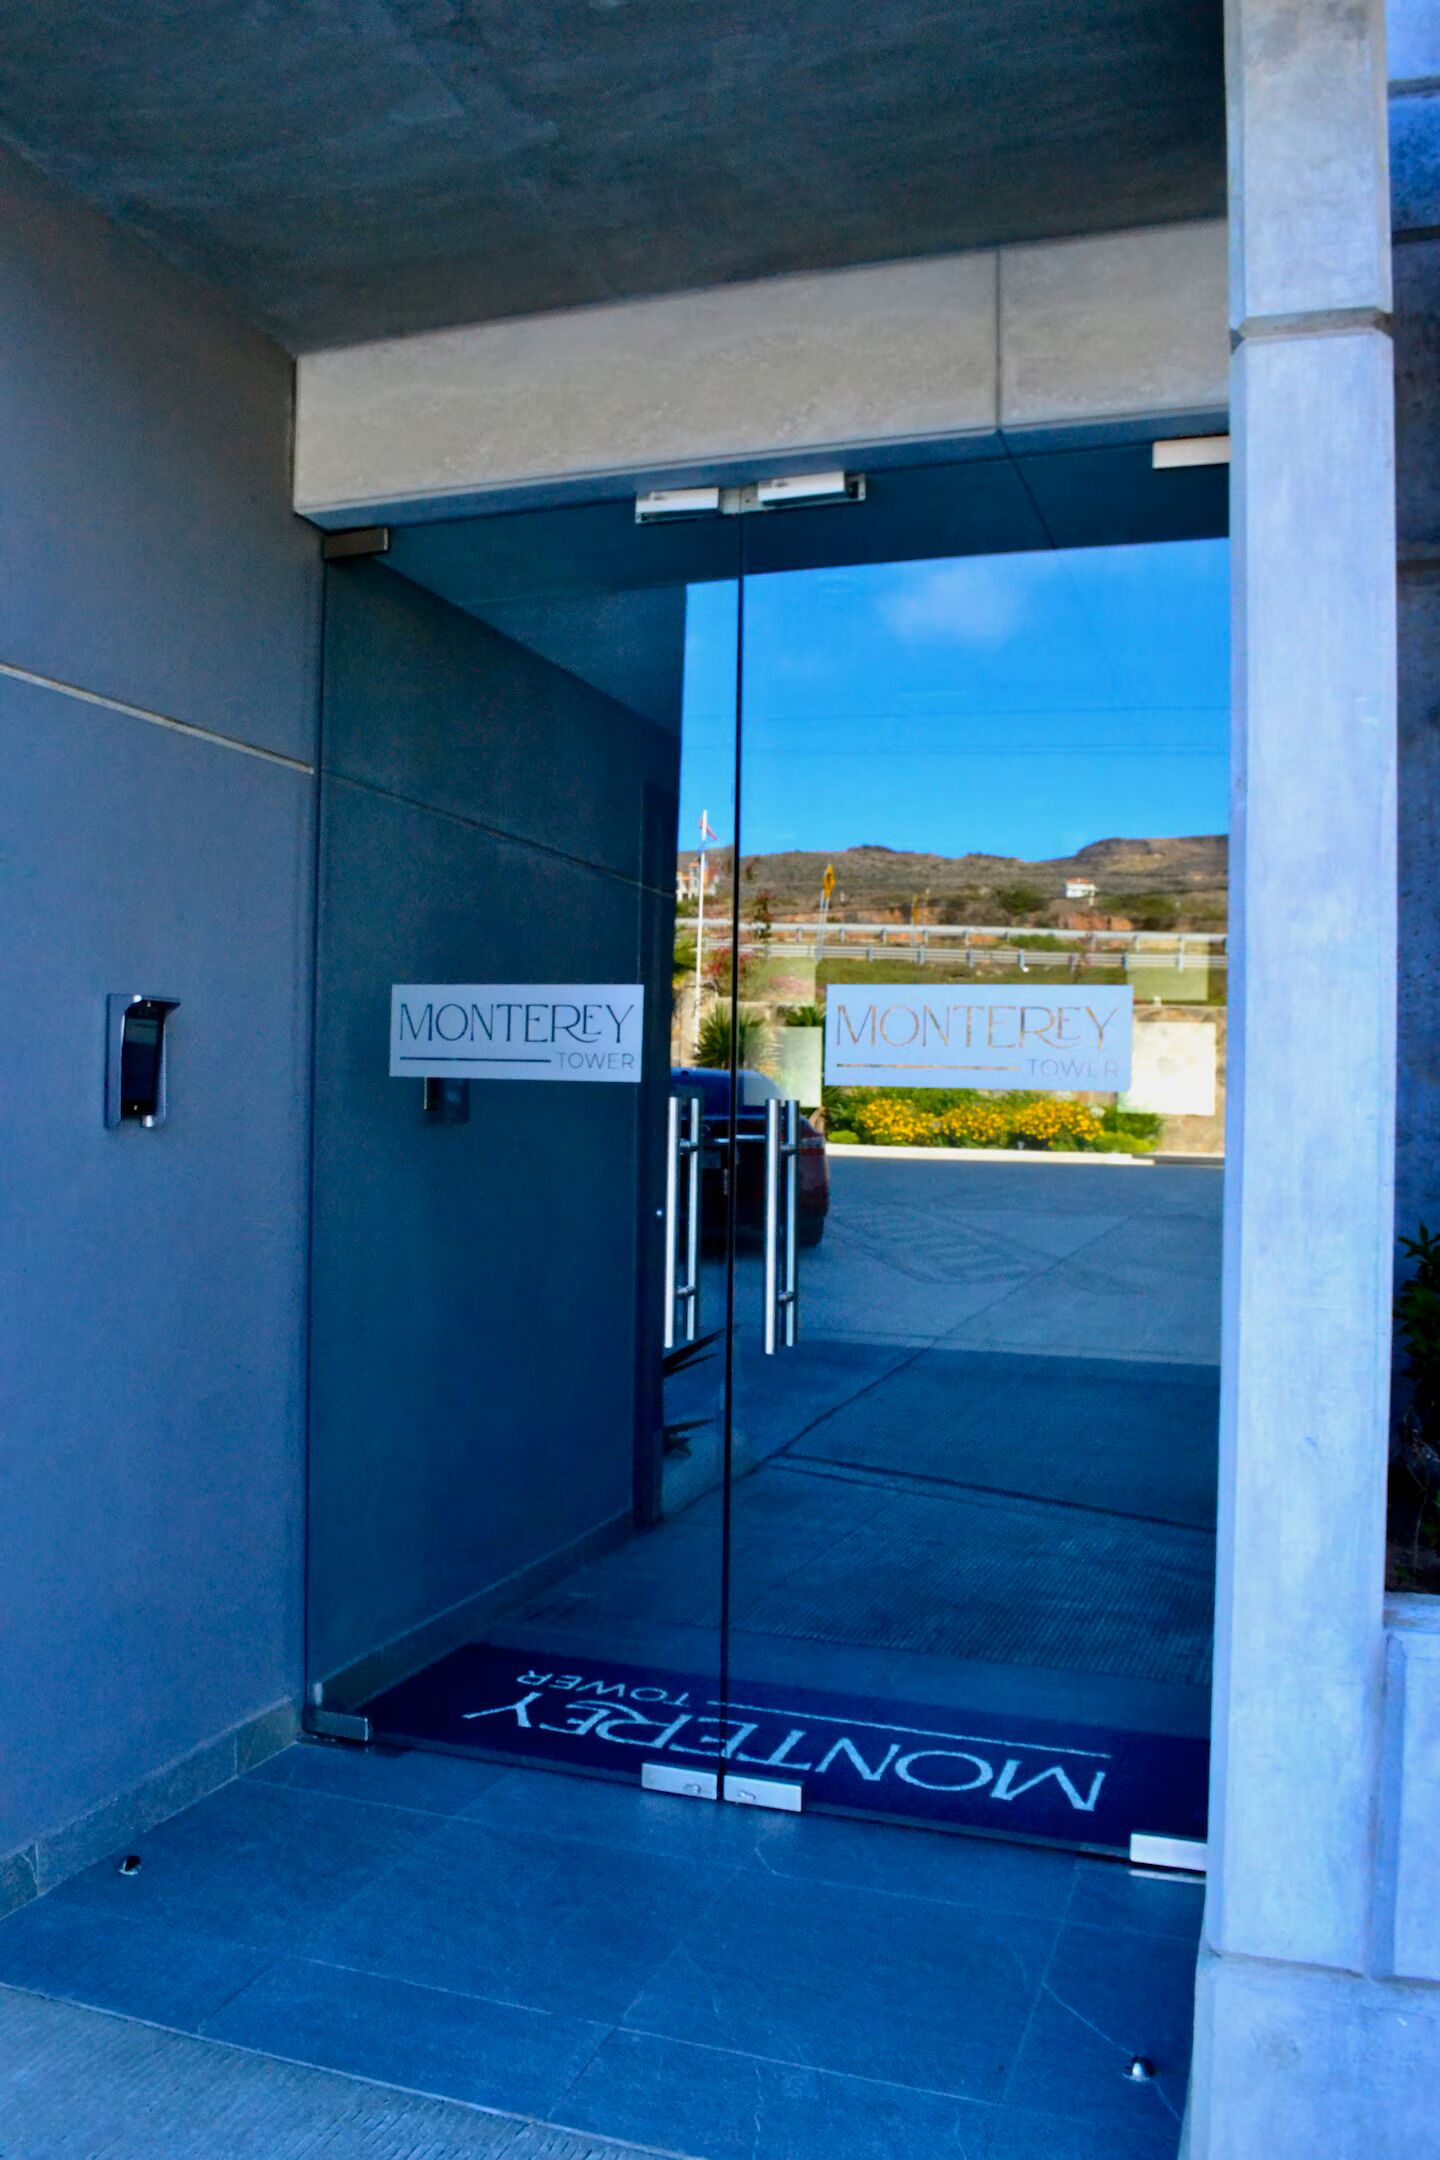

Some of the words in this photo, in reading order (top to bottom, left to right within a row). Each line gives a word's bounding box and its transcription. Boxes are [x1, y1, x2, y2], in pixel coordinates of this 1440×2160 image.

[399, 1003, 634, 1044] MONTEREY
[836, 1004, 1118, 1050] MONTEREY
[556, 1051, 634, 1070] TOWER
[1028, 1058, 1120, 1079] TOWER
[516, 1670, 690, 1708] TOWER
[462, 1692, 1106, 1812] MONTEREY
